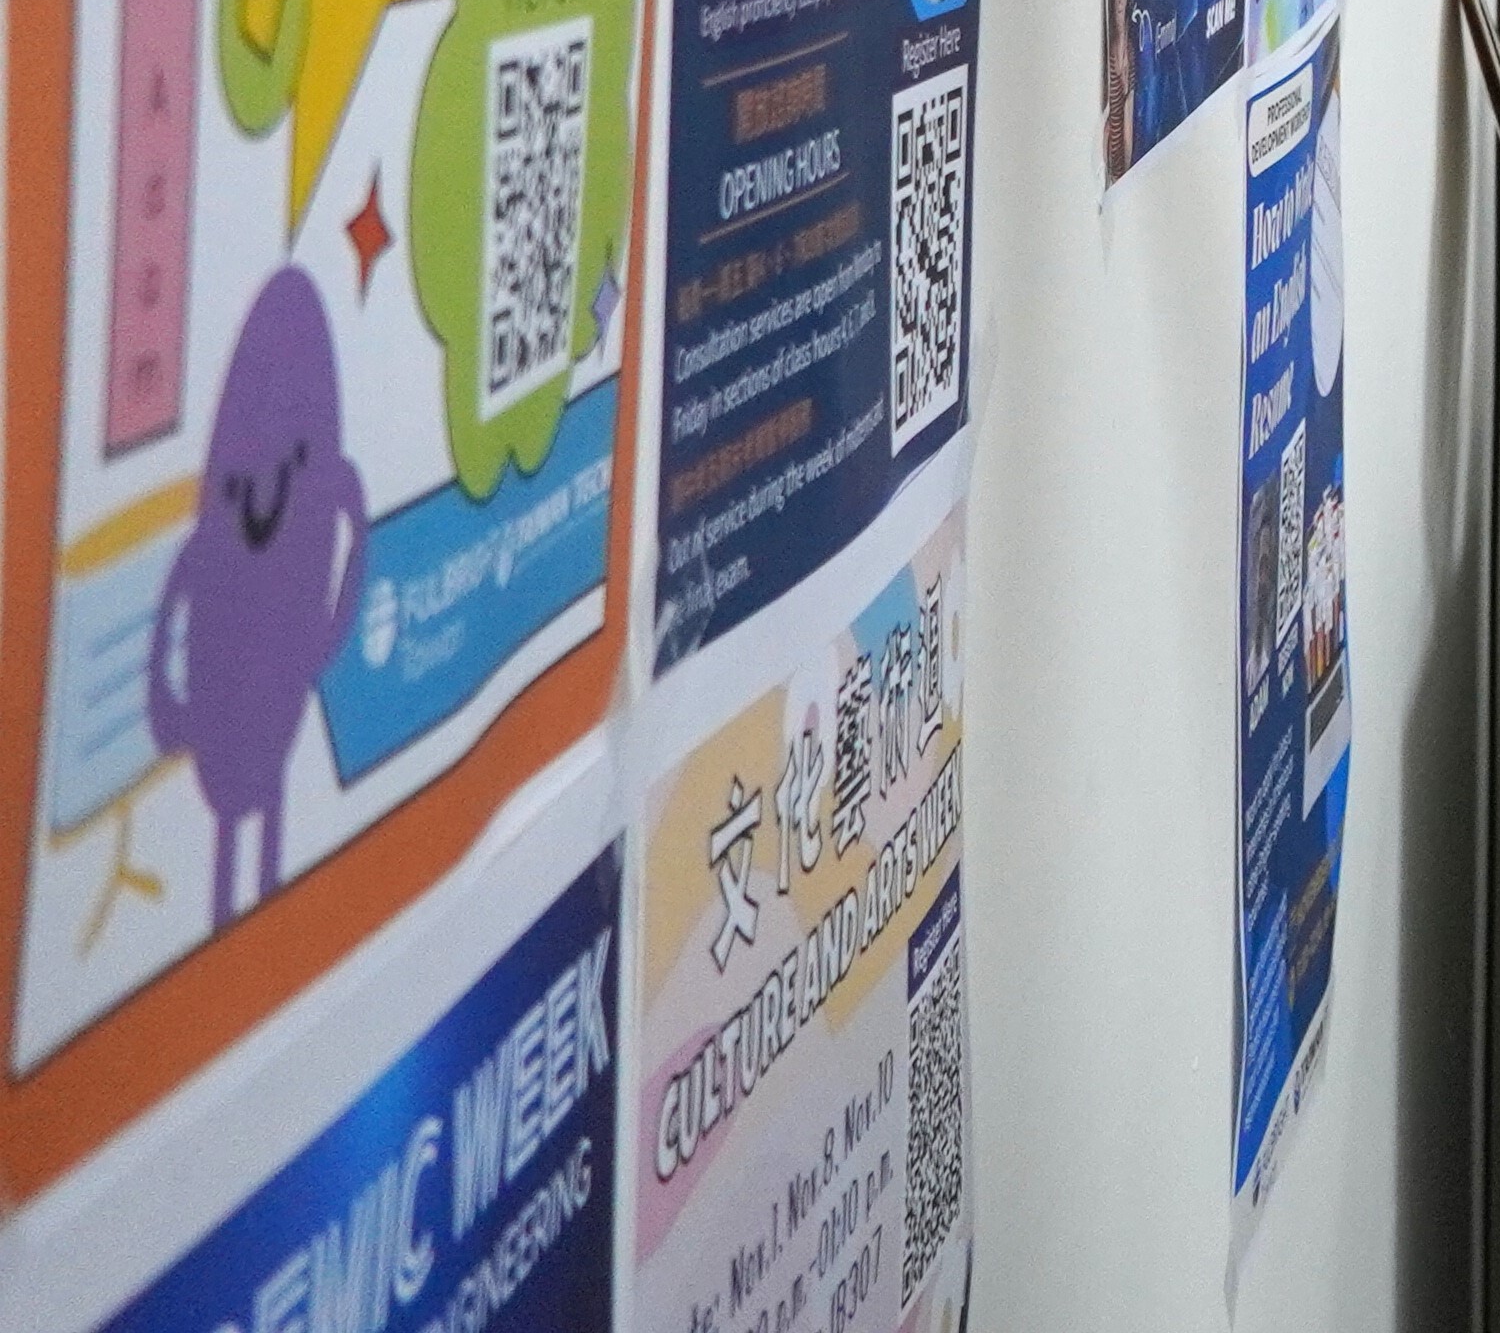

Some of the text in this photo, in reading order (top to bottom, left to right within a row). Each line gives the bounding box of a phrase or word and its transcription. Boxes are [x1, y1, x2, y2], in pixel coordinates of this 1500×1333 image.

[901, 18, 960, 86] Register Here
[1267, 76, 1302, 134] PROFESSIONAL
[719, 121, 841, 232] OPENING HOURS
[1251, 109, 1289, 175] DEVELOPMENT
[1251, 178, 1282, 278] How
[1283, 179, 1294, 245] to
[1251, 238, 1306, 368] an English
[709, 576, 944, 974] 文化藝術週
[655, 739, 962, 1183] CULTURE AND ARTS WEEK
[453, 926, 612, 1244] WEEK
